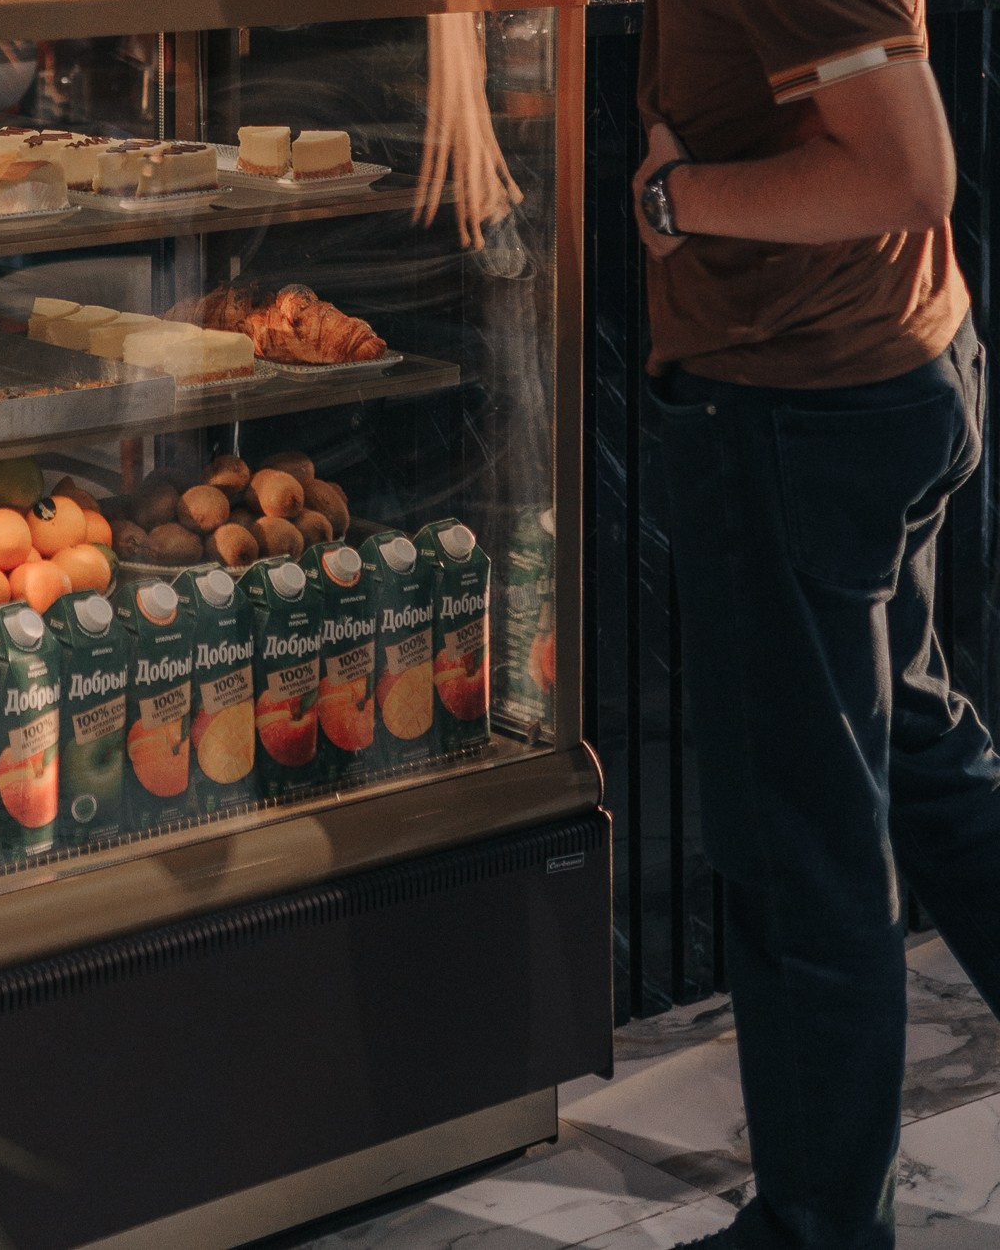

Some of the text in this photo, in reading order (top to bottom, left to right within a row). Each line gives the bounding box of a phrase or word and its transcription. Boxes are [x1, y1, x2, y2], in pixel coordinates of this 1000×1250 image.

[399, 633, 427, 656] 100%
[338, 647, 369, 668] 100%
[213, 670, 245, 695] 100%
[279, 662, 313, 684] 100%
[153, 687, 185, 711] 100%
[77, 705, 110, 729] 100%
[23, 718, 53, 742] 100%
